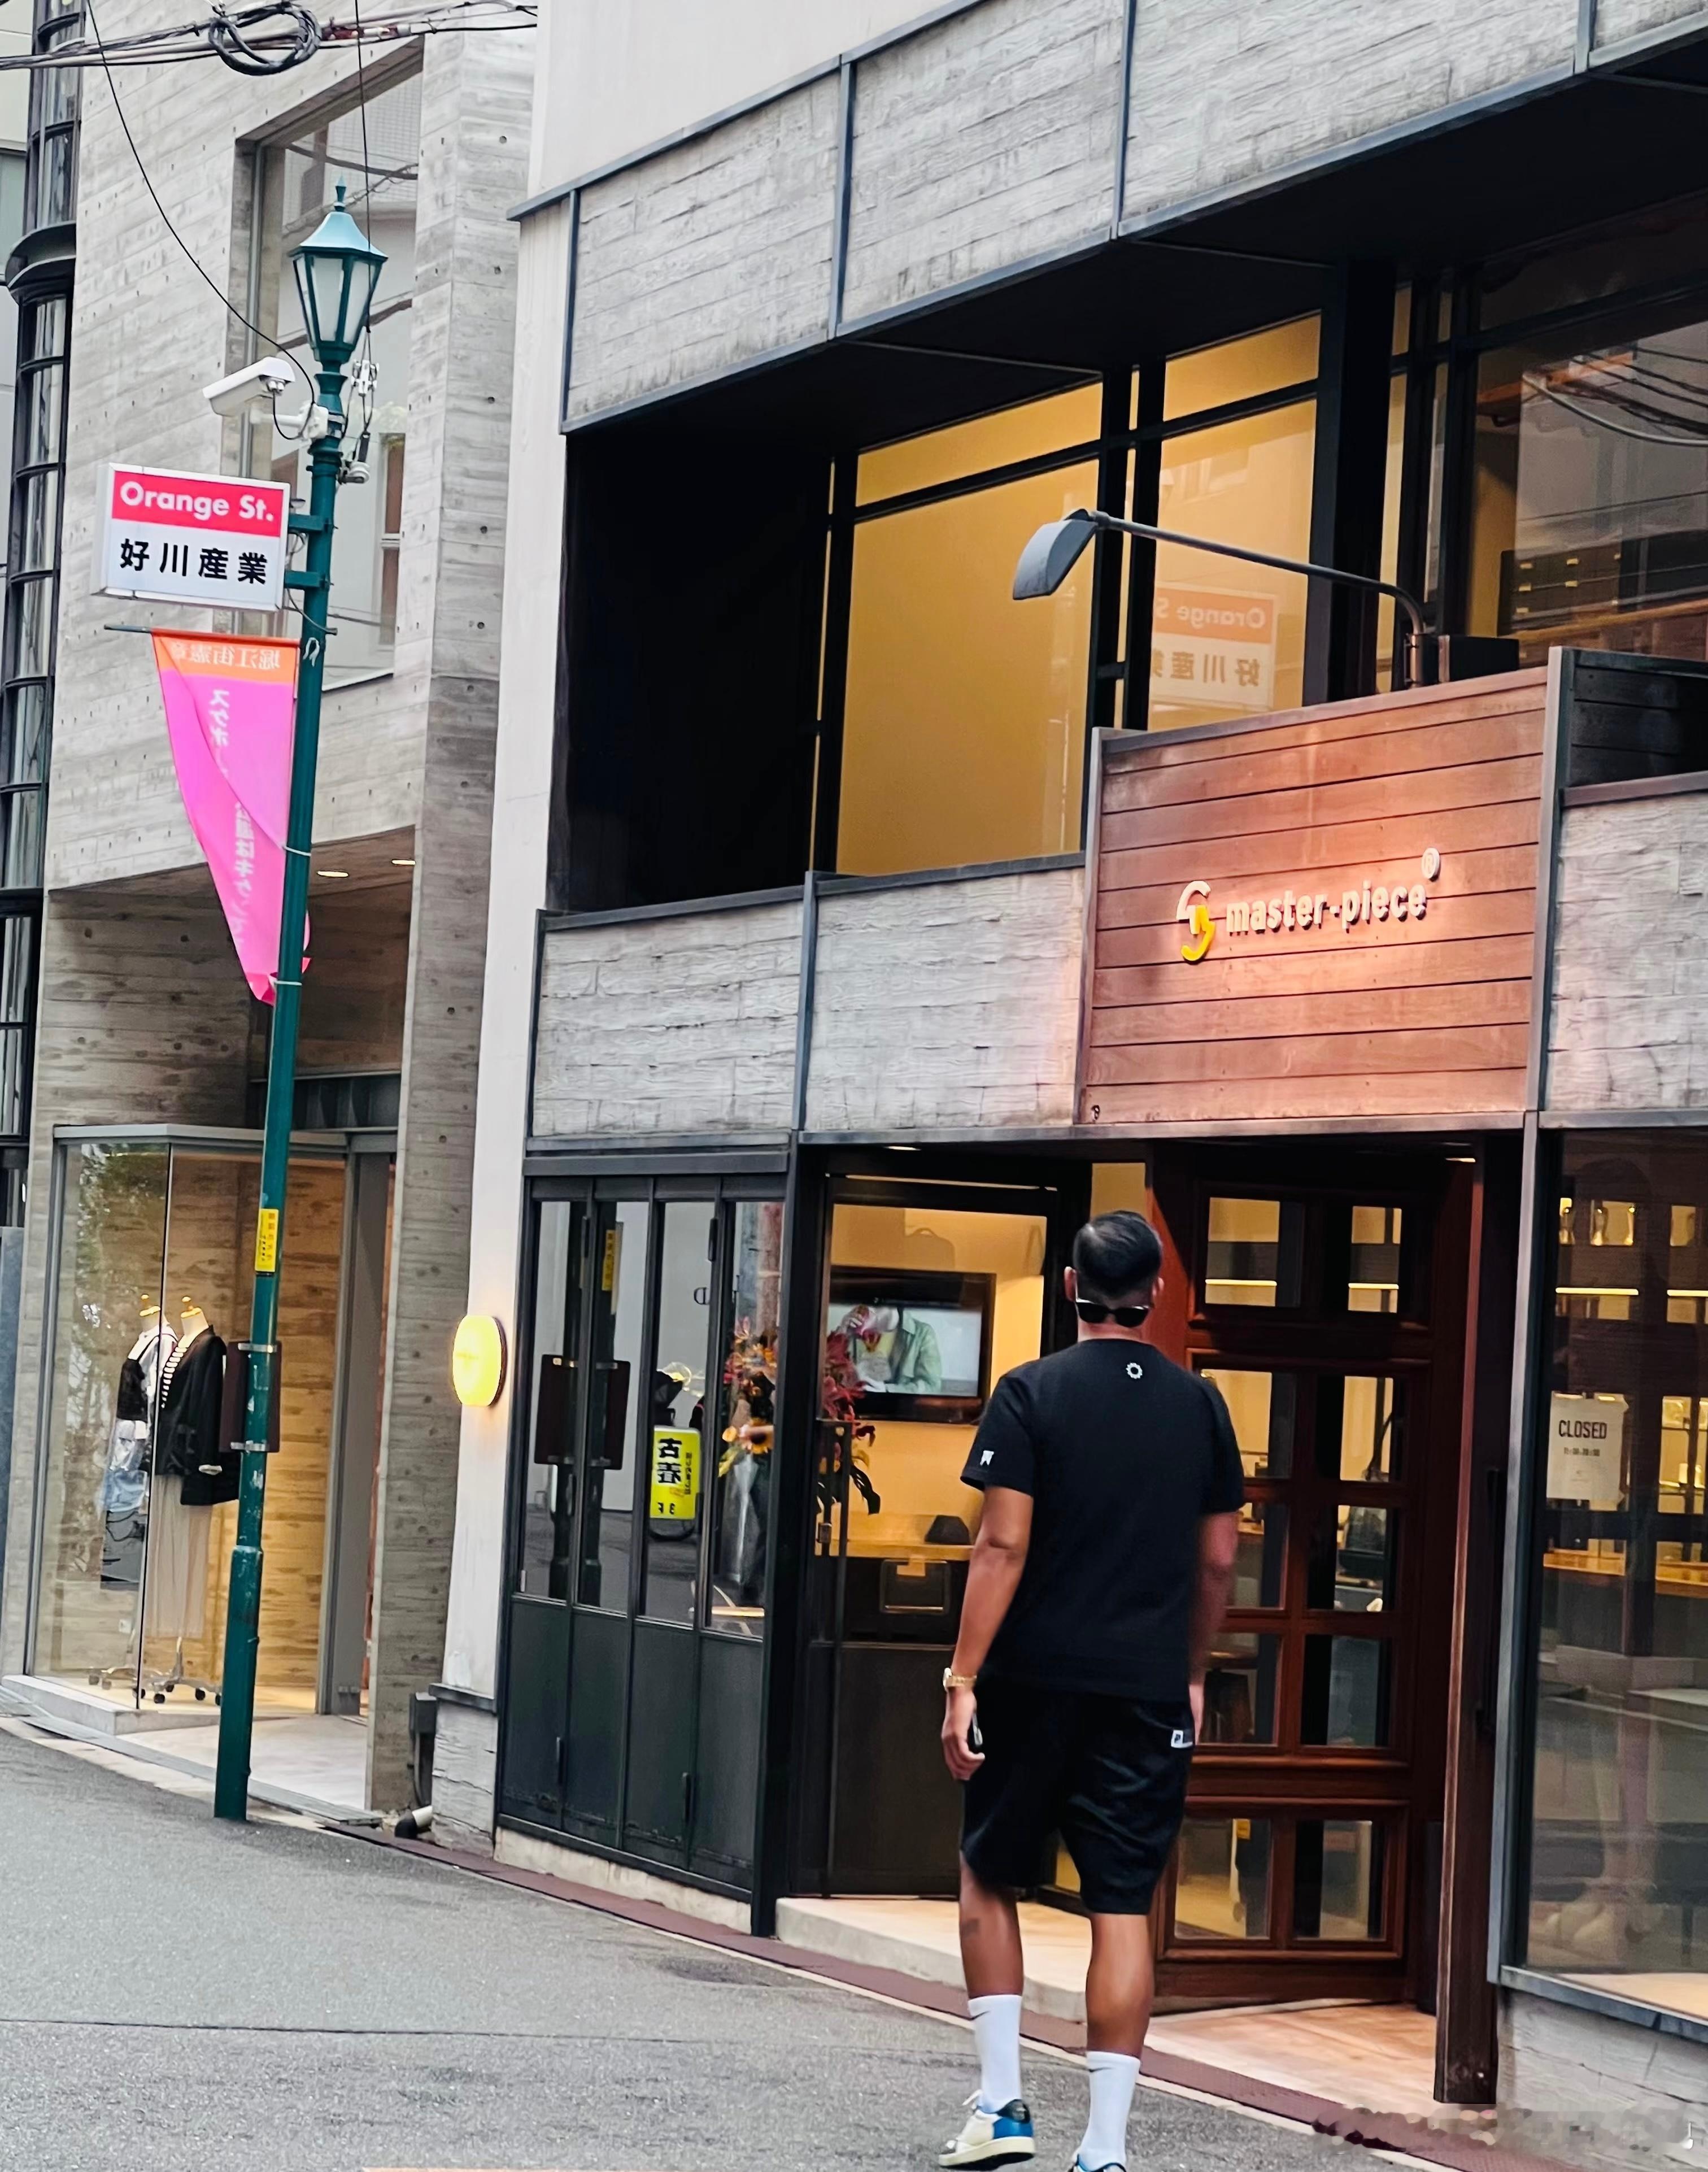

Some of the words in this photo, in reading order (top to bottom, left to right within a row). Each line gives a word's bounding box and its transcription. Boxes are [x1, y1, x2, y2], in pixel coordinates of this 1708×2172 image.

[120, 481, 229, 521] Orange
[239, 495, 274, 522] St.
[120, 538, 268, 585] 好川産業
[1558, 1420, 1607, 1439] CLOSED
